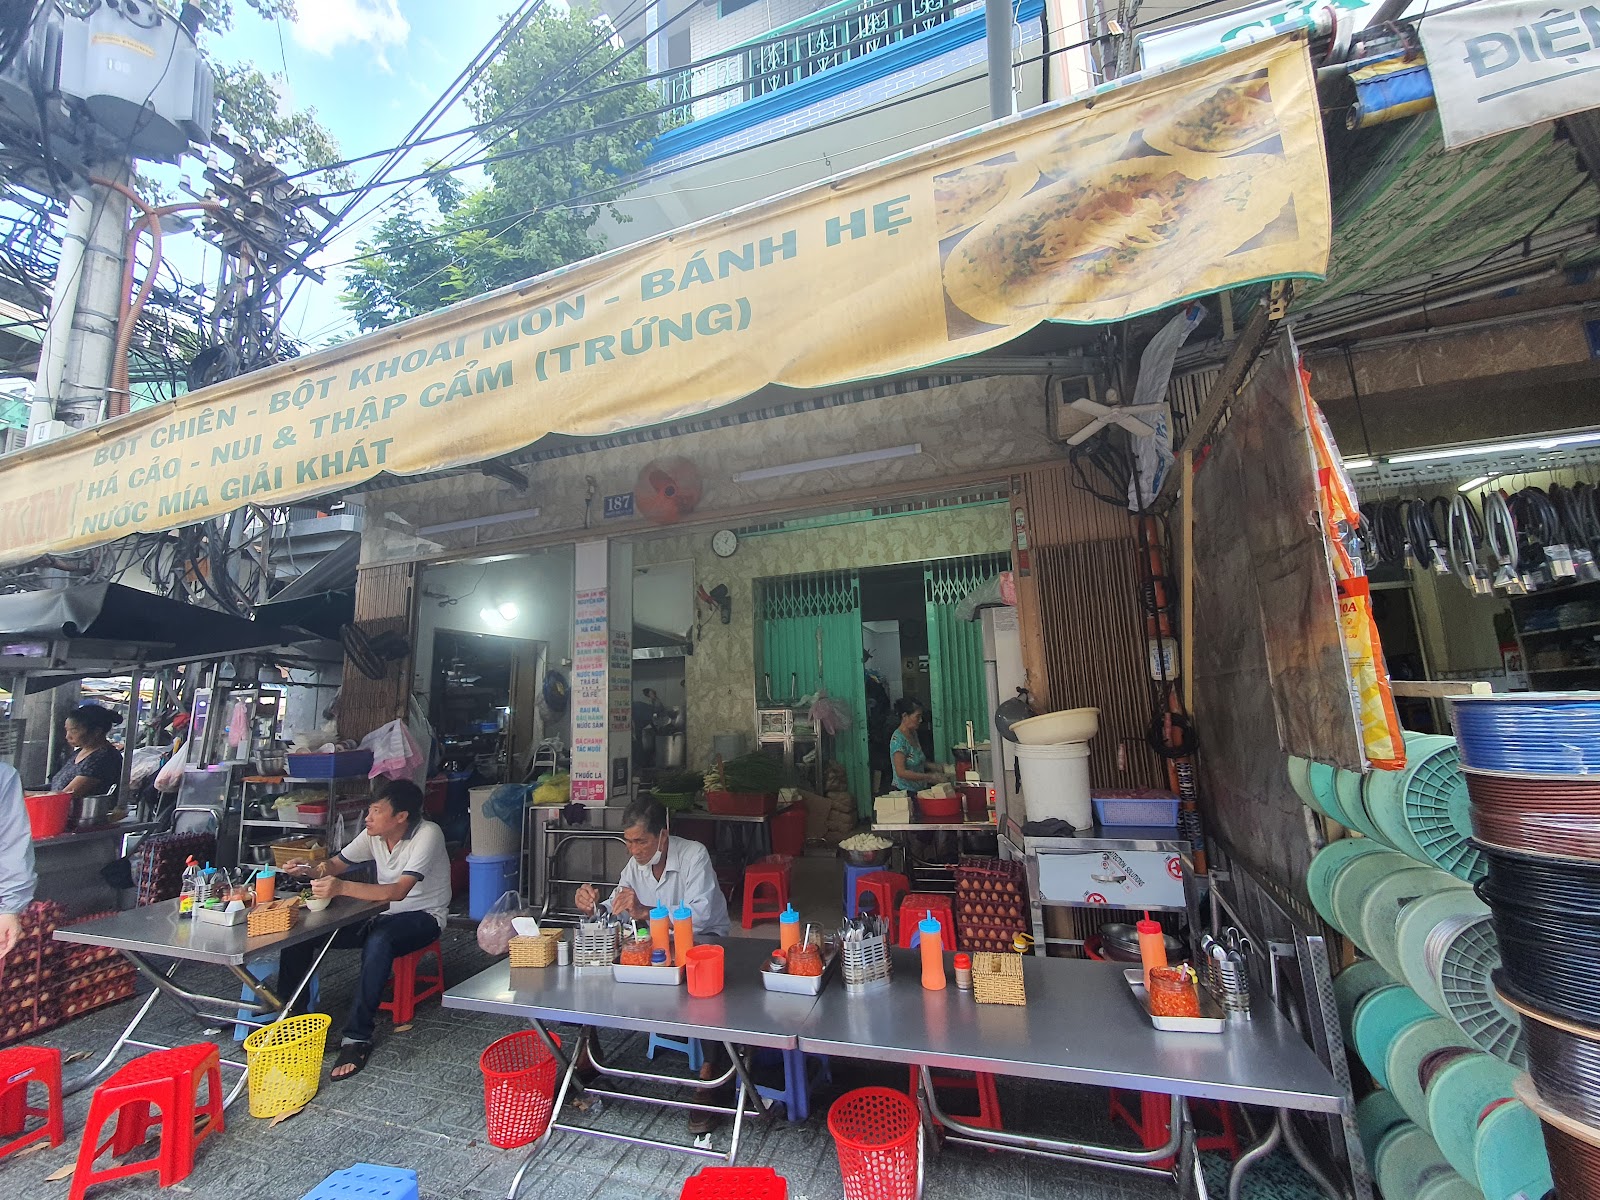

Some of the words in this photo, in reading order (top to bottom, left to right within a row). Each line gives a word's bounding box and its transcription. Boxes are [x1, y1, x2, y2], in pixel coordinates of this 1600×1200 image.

[87, 472, 118, 501] HÁ
[128, 455, 181, 490] CẢO
[210, 433, 262, 467] NUI
[272, 425, 297, 450] &
[309, 393, 408, 440] THẬP
[419, 359, 514, 408] CẨM
[535, 297, 752, 382] (TRỨNG)
[93, 435, 142, 467] BỘT
[150, 406, 237, 449] CHIÊN
[268, 376, 338, 414] BỘT
[348, 335, 468, 391] KHOAI
[641, 229, 797, 302] BÁNH
[825, 194, 913, 247] HẸ
[80, 497, 149, 536] NƯỚC
[157, 484, 210, 517] MÍA
[220, 462, 282, 501] GIẢI
[295, 437, 394, 484] KHÁT
[607, 495, 630, 511] 187
